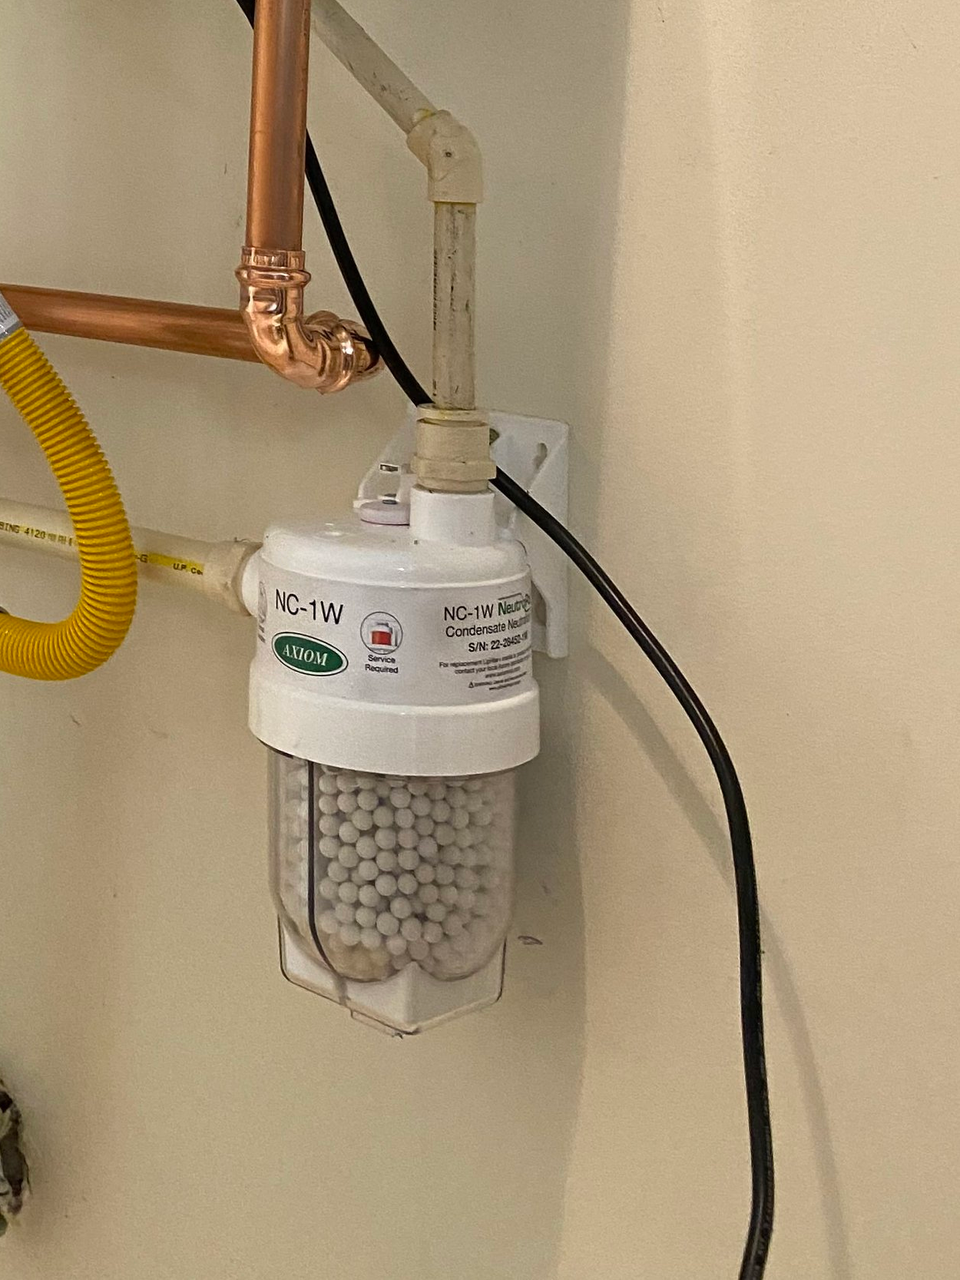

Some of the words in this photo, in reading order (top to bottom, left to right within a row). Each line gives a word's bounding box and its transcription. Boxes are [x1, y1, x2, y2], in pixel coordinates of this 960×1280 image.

[24, 526, 46, 540] 4120
[275, 588, 344, 625] NC-1W
[444, 603, 494, 621] NC-1W
[445, 622, 507, 638] Condensate
[468, 641, 489, 653] S/N:
[282, 643, 328, 667] AXIOM
[367, 654, 396, 664] Service
[365, 663, 399, 674] Required
